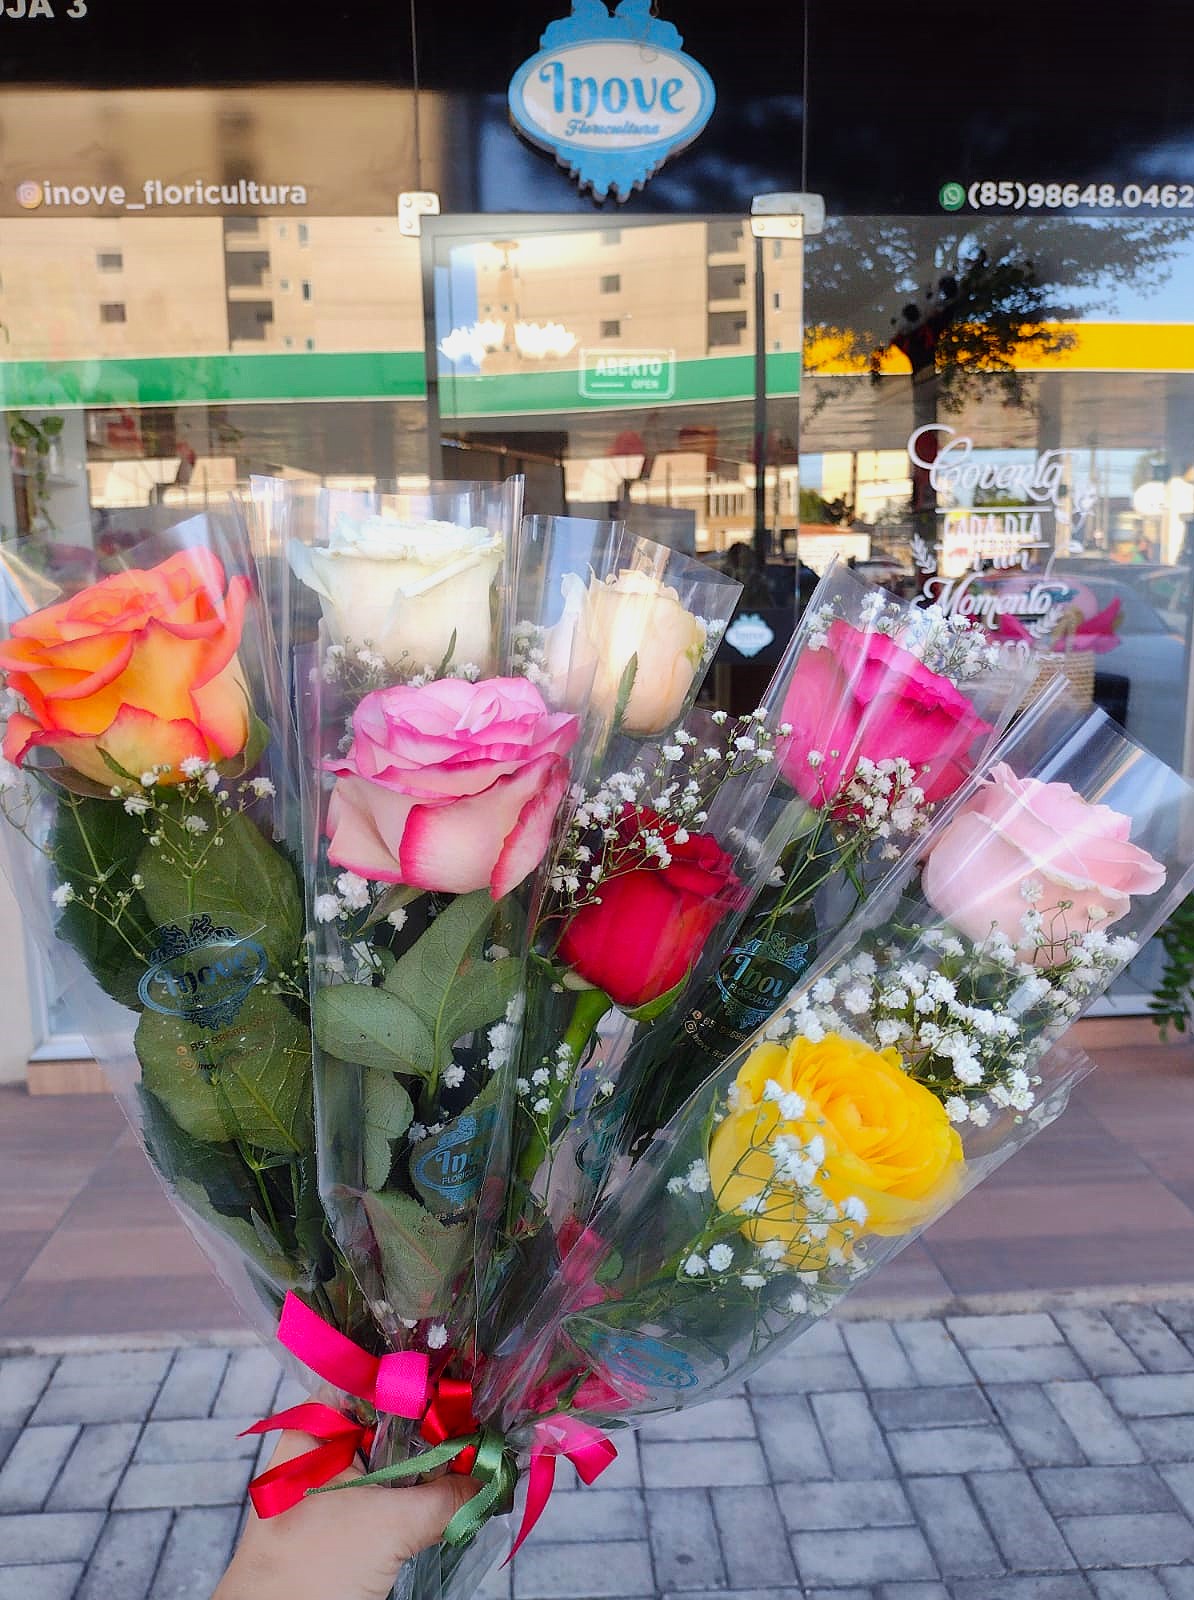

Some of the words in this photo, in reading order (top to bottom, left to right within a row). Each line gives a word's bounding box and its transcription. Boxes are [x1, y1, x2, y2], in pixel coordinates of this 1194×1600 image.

[0, 0, 55, 18] JA
[66, 0, 88, 18] 3
[539, 62, 686, 117] Inove
[43, 179, 307, 210] inove_floricultura
[967, 181, 1194, 210] (85)98648.0462
[595, 357, 662, 377] ABERTO
[910, 571, 1069, 630] Momento
